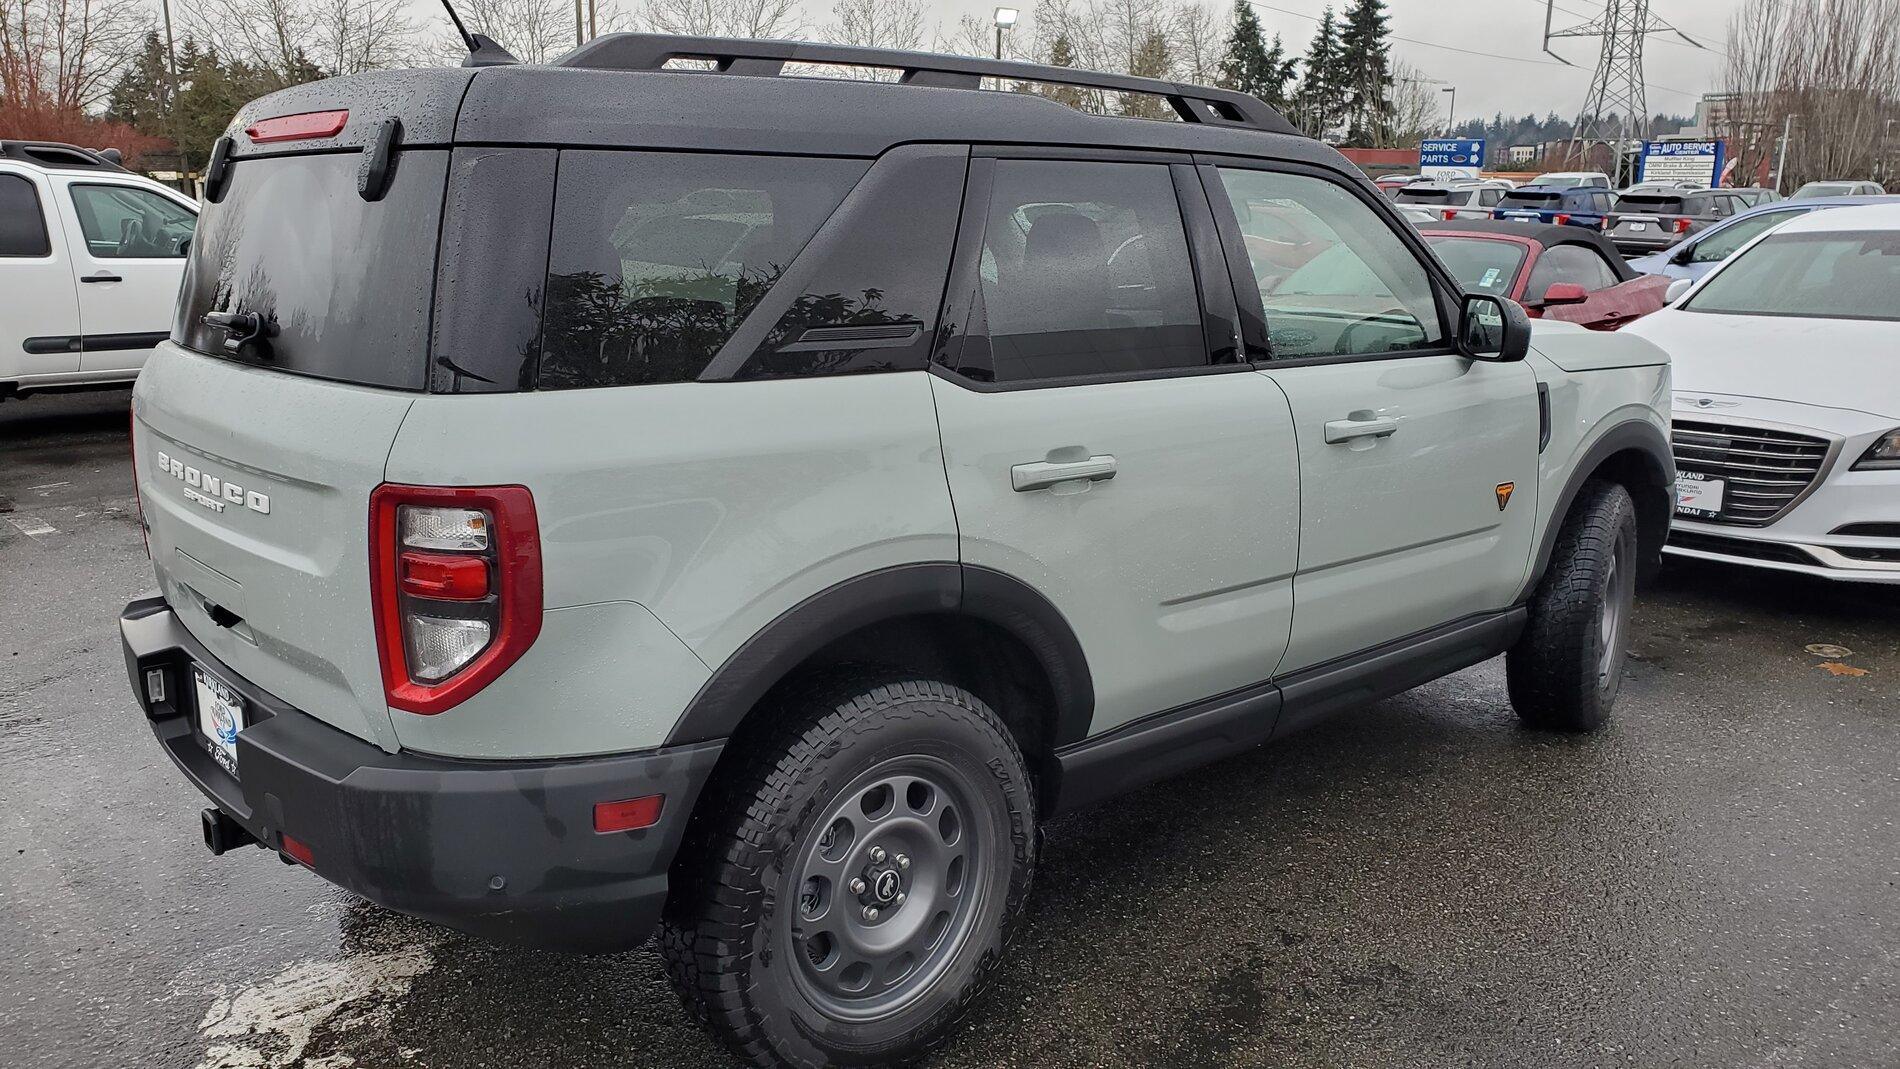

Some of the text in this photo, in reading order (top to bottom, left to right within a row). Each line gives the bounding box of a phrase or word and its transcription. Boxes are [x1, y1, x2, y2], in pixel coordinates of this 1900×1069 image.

[1422, 143, 1457, 152] SERVICE
[1661, 143, 1682, 154] AUTO
[1683, 143, 1715, 154] SERVICE
[1421, 154, 1449, 163] PARTS
[159, 451, 269, 515] BRONCO
[183, 487, 225, 513] SPORT
[214, 746, 230, 770] Ford
